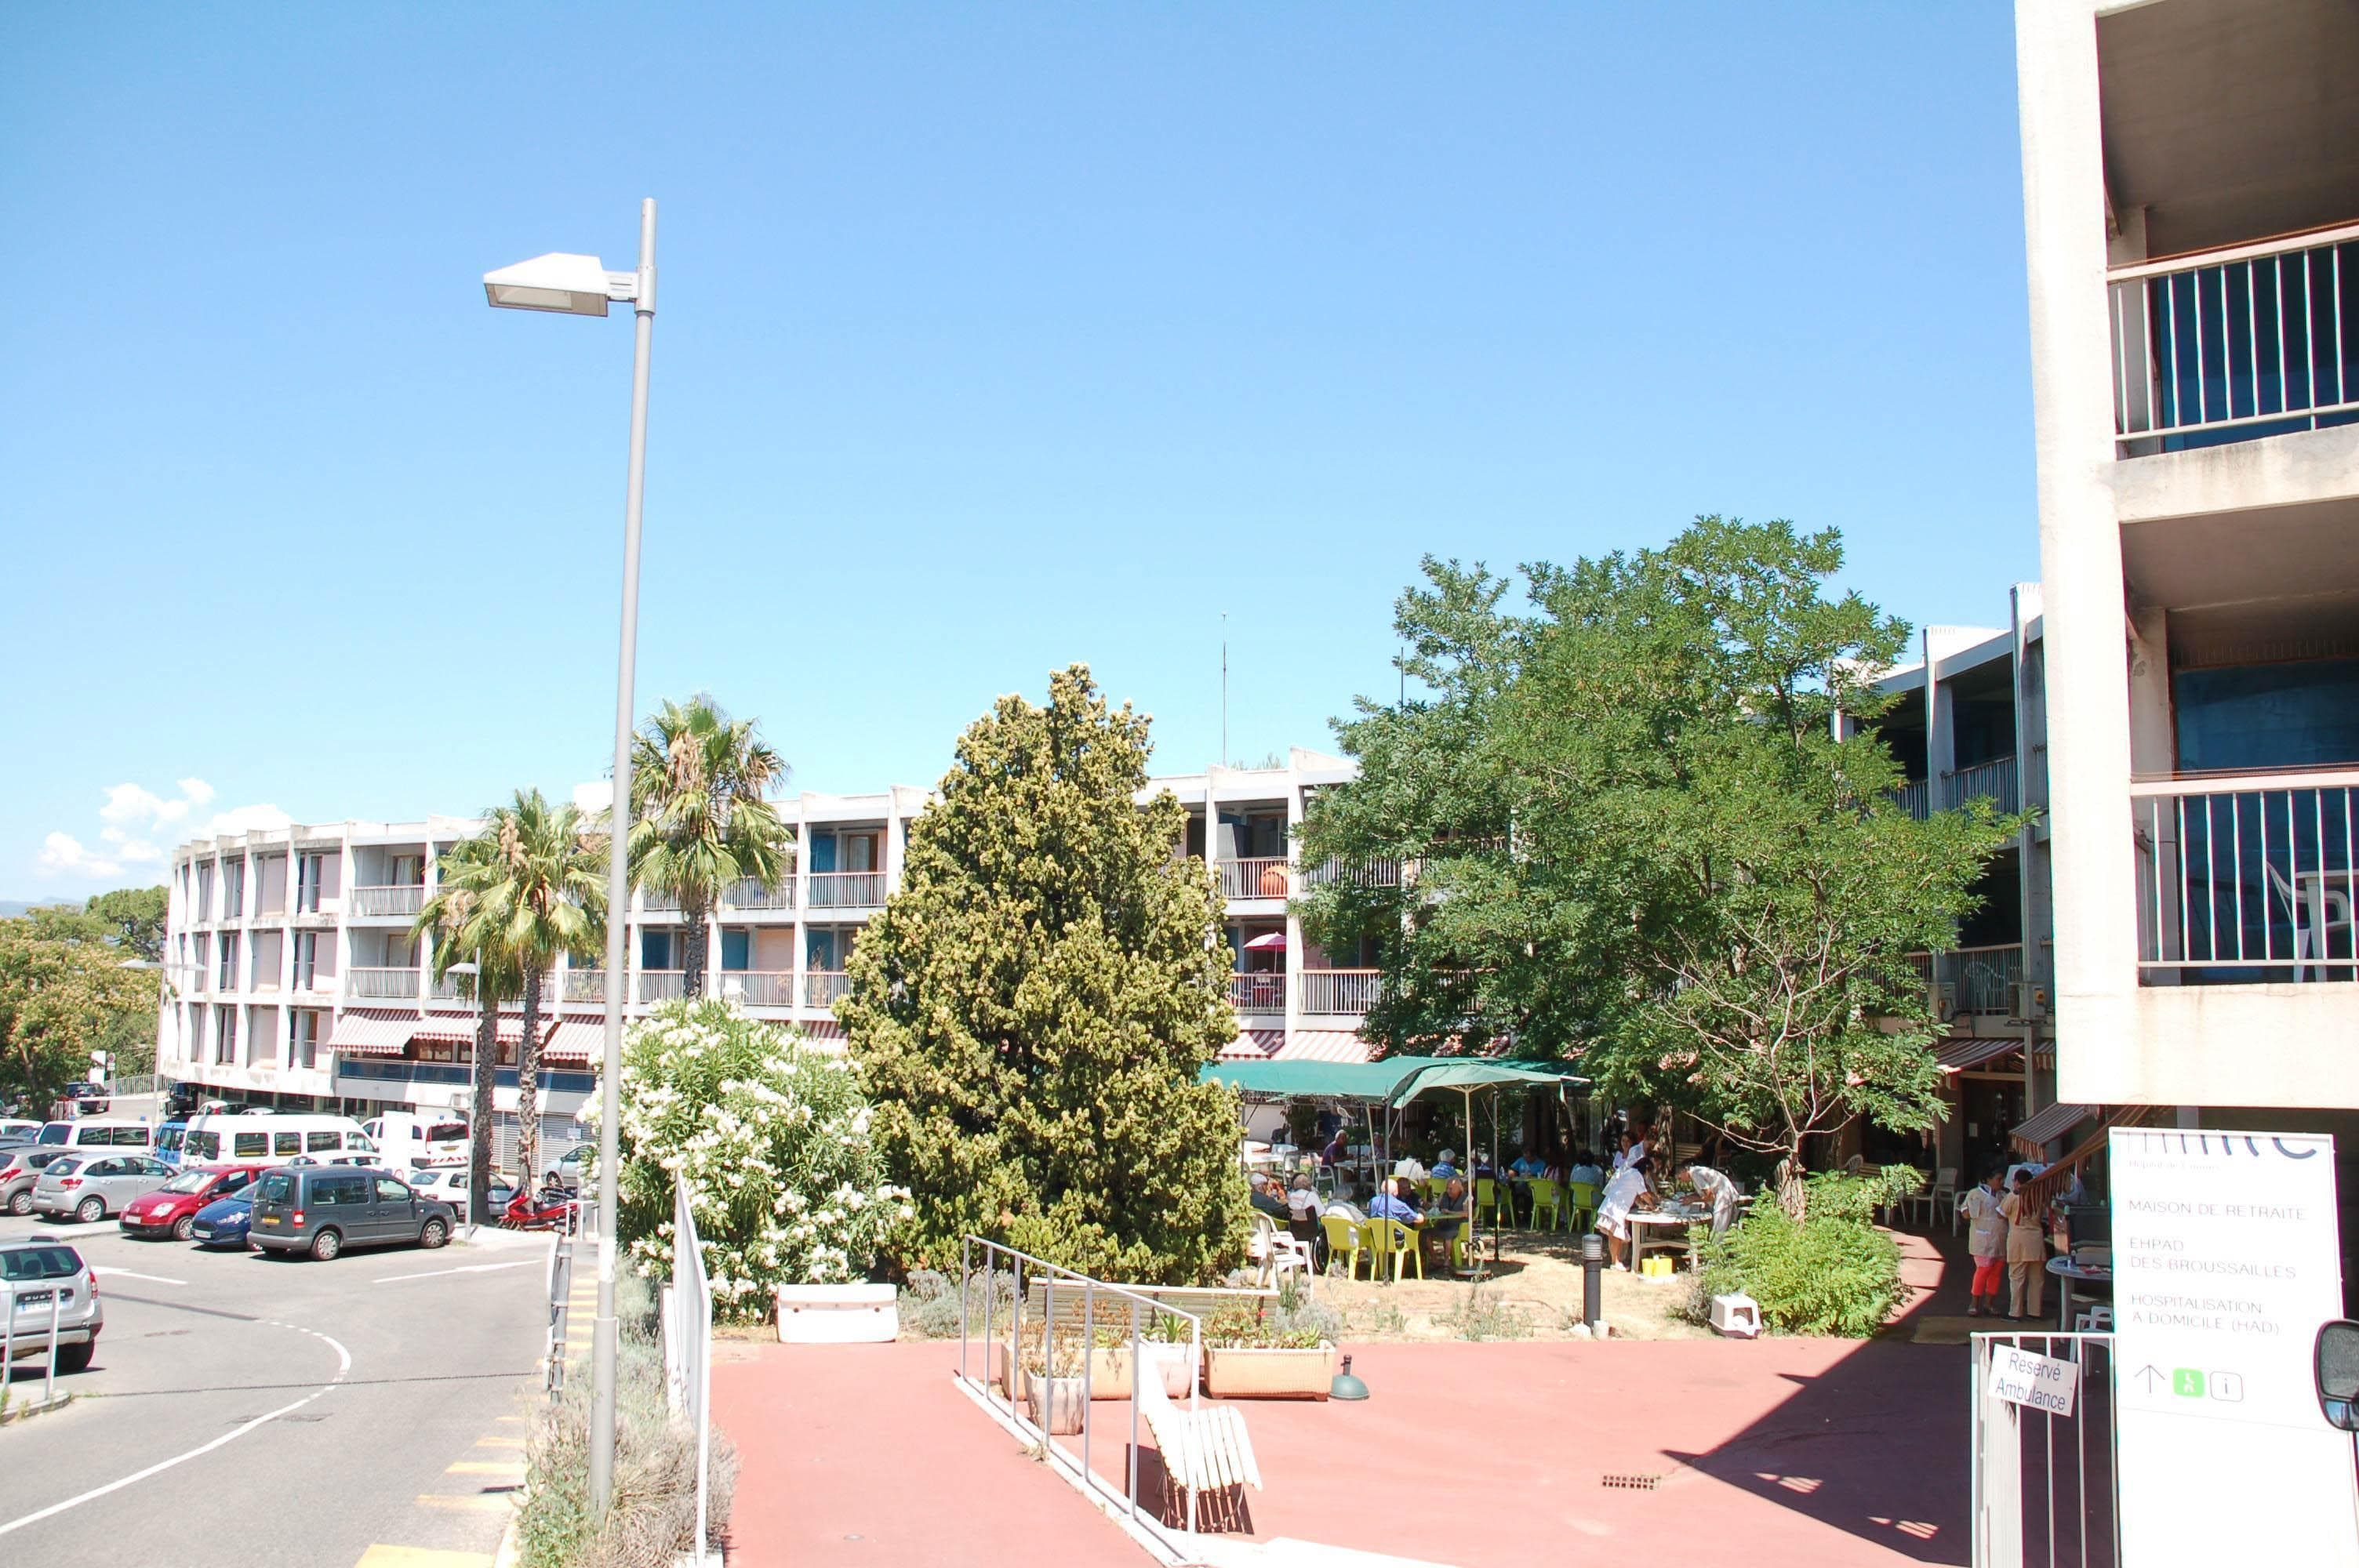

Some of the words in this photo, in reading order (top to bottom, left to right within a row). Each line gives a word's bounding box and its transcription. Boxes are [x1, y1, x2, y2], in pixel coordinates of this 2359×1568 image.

[2128, 1199, 2192, 1215] MAISON
[2198, 1203, 2219, 1216] DE
[2226, 1204, 2307, 1221] RETRAITE
[2129, 1236, 2184, 1252] EHPAD
[2130, 1255, 2162, 1269] DES
[2168, 1258, 2296, 1279] BROUSSAILLES
[24, 1292, 65, 1301] DUSTR
[2132, 1294, 2263, 1314] HOSPITALISATION
[2149, 1311, 2222, 1329] DOMICILE
[2231, 1319, 2280, 1336] (HAD)
[2008, 1351, 2061, 1381] Réservé
[1996, 1377, 2066, 1411] Ambulance
